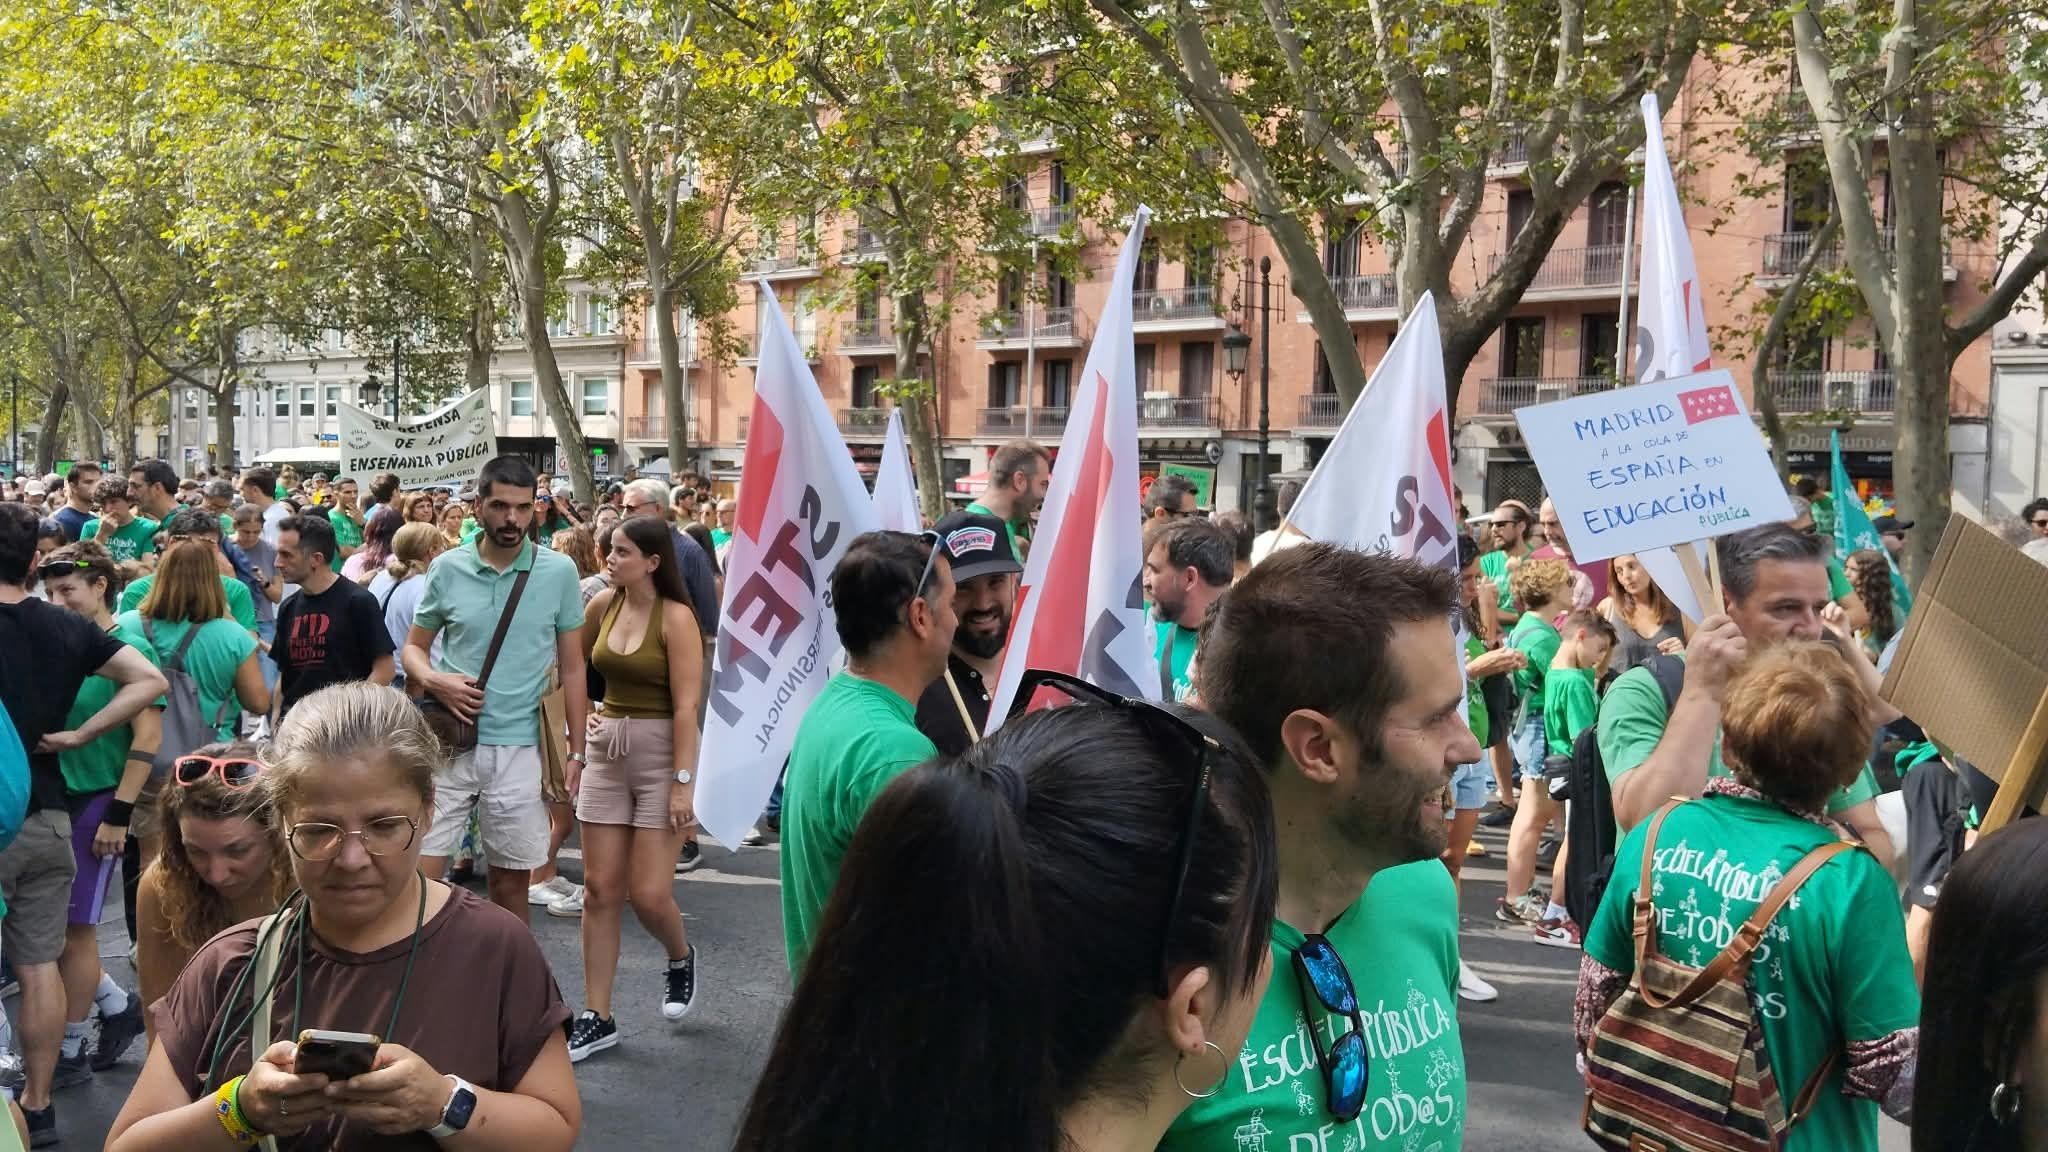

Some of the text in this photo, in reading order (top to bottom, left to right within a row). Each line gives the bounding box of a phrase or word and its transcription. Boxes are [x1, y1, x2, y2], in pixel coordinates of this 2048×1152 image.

[1573, 404, 1674, 441] MADRID
[350, 440, 489, 472] ENSEÑANZA PÚBLICA
[394, 438, 416, 449] DE
[1601, 447, 1609, 461] A
[1618, 444, 1632, 455] LA
[1643, 435, 1672, 449] COLA
[435, 472, 455, 482] JUAN
[456, 467, 476, 478] GRIS
[1586, 454, 1724, 490] ESPAÑA EN
[1651, 848, 1717, 887] SCUELA
[1354, 1080, 1454, 1151] TOD@S
